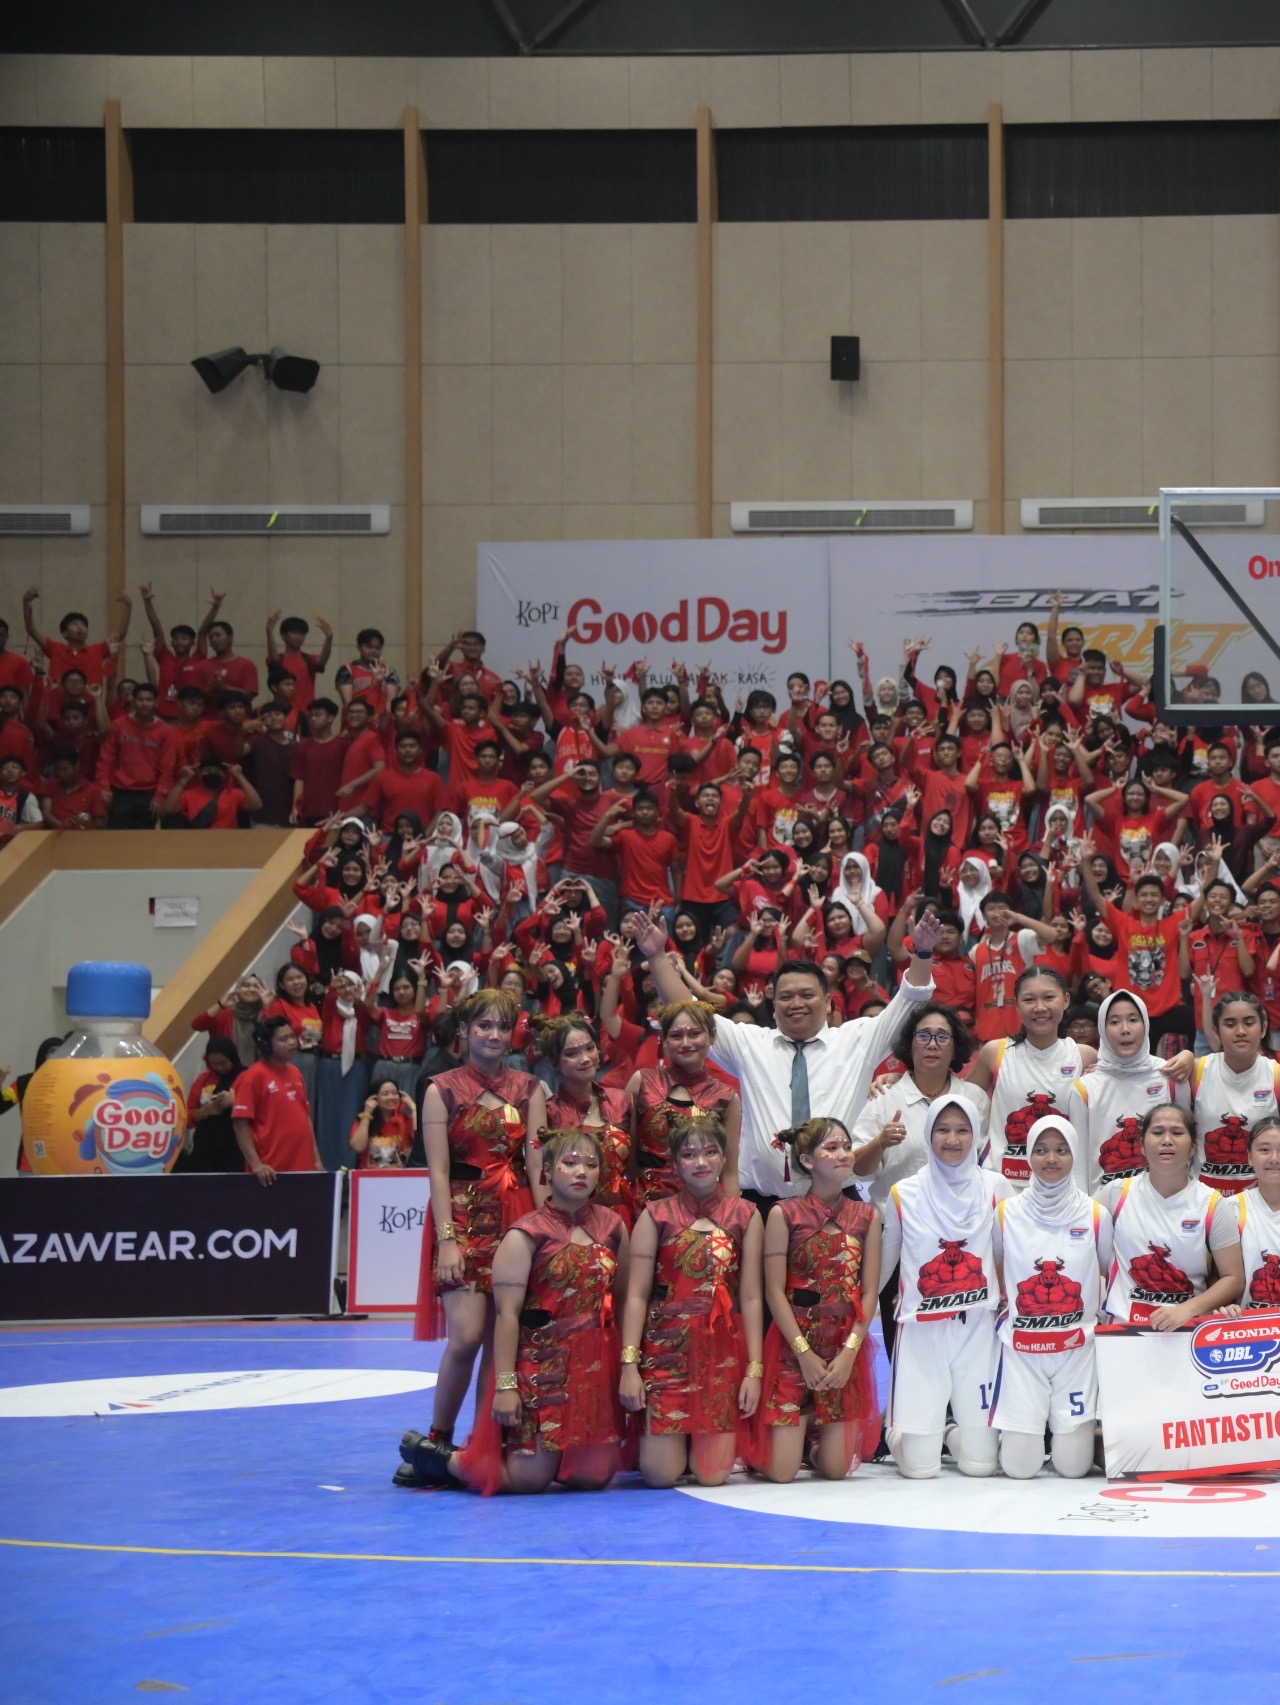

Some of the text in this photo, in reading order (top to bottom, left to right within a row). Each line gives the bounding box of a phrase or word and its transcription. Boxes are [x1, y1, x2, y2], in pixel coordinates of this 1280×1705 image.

[567, 598, 689, 644] Good
[697, 597, 787, 655] Day
[738, 672, 768, 685] RASA
[96, 1102, 177, 1127] Good
[107, 1127, 171, 1157] Day
[1005, 1168, 1018, 1177] One
[916, 1287, 989, 1312] SMAGA
[1129, 1288, 1195, 1304] SMAG
[1012, 1311, 1084, 1329] SMAGA
[1015, 1342, 1030, 1350] One
[1224, 1346, 1253, 1362] DBL
[1230, 1378, 1260, 1390] Good
[1069, 1391, 1085, 1417] 5
